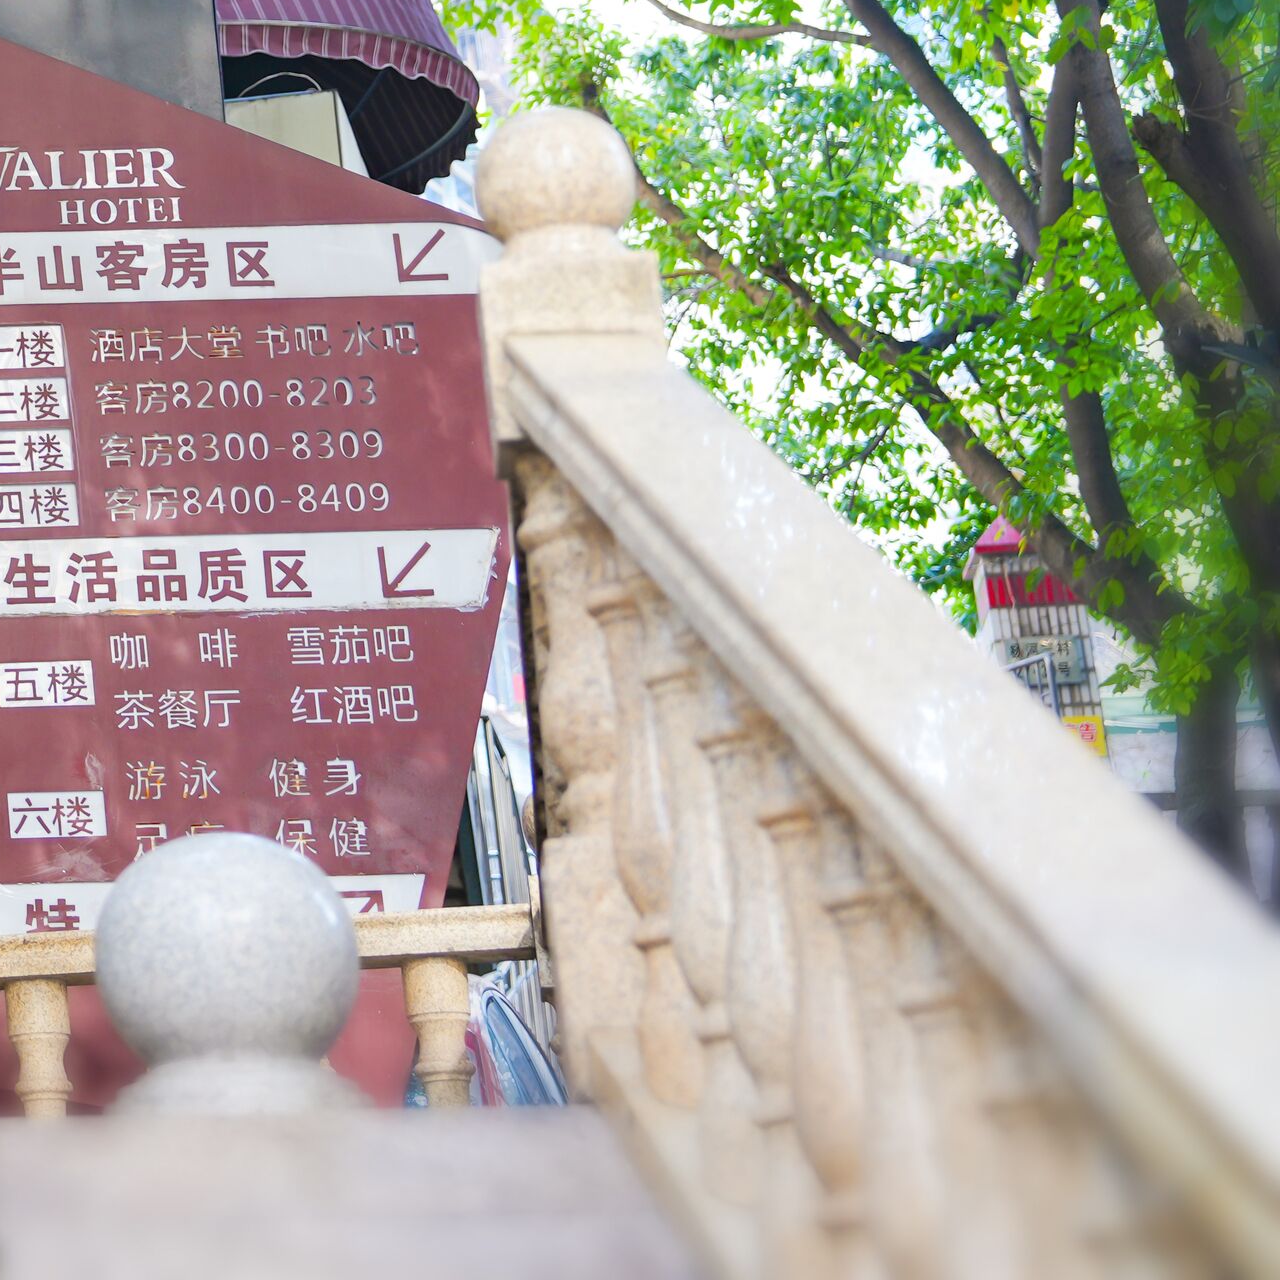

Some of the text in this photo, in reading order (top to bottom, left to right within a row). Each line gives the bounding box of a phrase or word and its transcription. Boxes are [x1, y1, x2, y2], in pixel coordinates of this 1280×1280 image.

[89, 323, 245, 364] 酒店大堂
[255, 322, 333, 360] 书吧
[342, 320, 420, 357] 水吧
[93, 375, 378, 417] 客房8200-8203
[99, 429, 385, 469] 客房8300-8309
[103, 481, 391, 523] 客房8400-8409
[2, 547, 313, 605] 生活品质区
[287, 624, 416, 666] 雪茄吧
[3, 663, 90, 705] 五楼
[113, 684, 419, 731] 茶餐厅 红酒吧
[124, 756, 362, 801] 游泳 健身
[12, 795, 94, 837] 六楼
[133, 816, 372, 862] 足 保健
